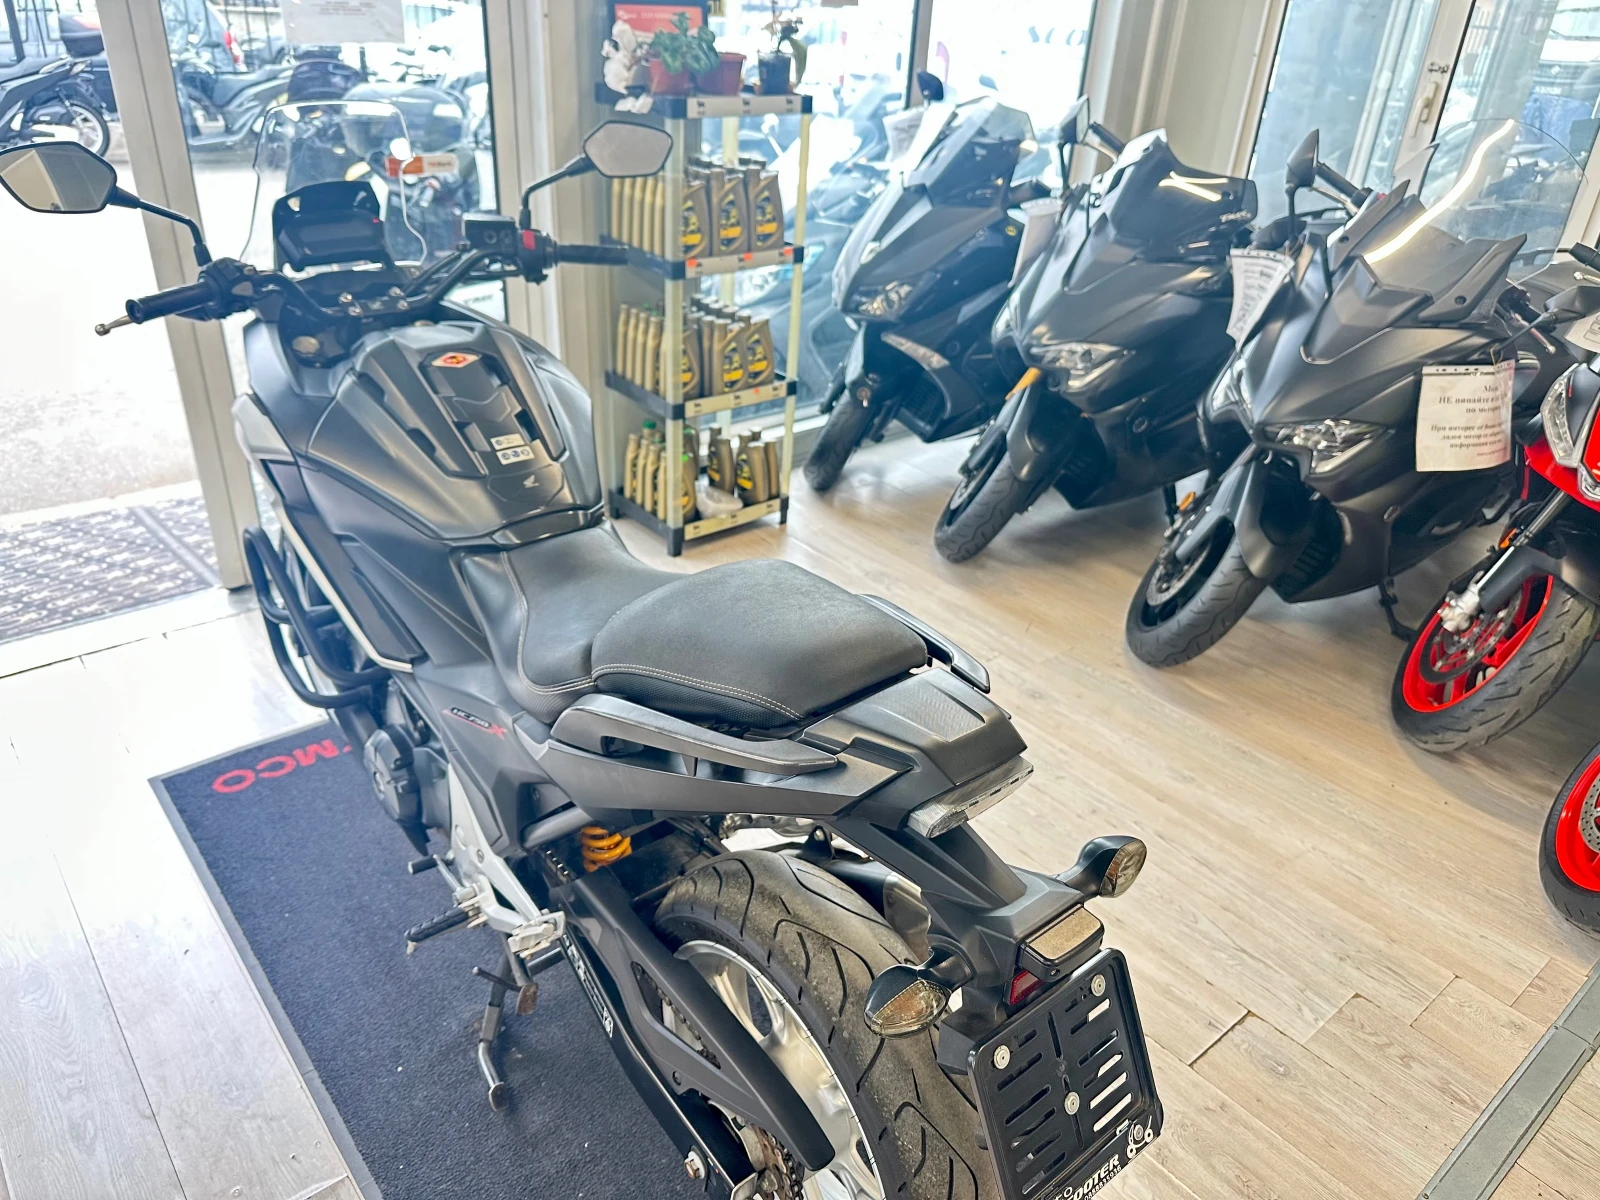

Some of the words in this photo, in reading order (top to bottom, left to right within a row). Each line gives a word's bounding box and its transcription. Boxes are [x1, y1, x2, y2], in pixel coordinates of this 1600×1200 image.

[1438, 396, 1453, 405] НЕ
[212, 739, 352, 793] MCO
[1067, 1153, 1120, 1200] OOTER
